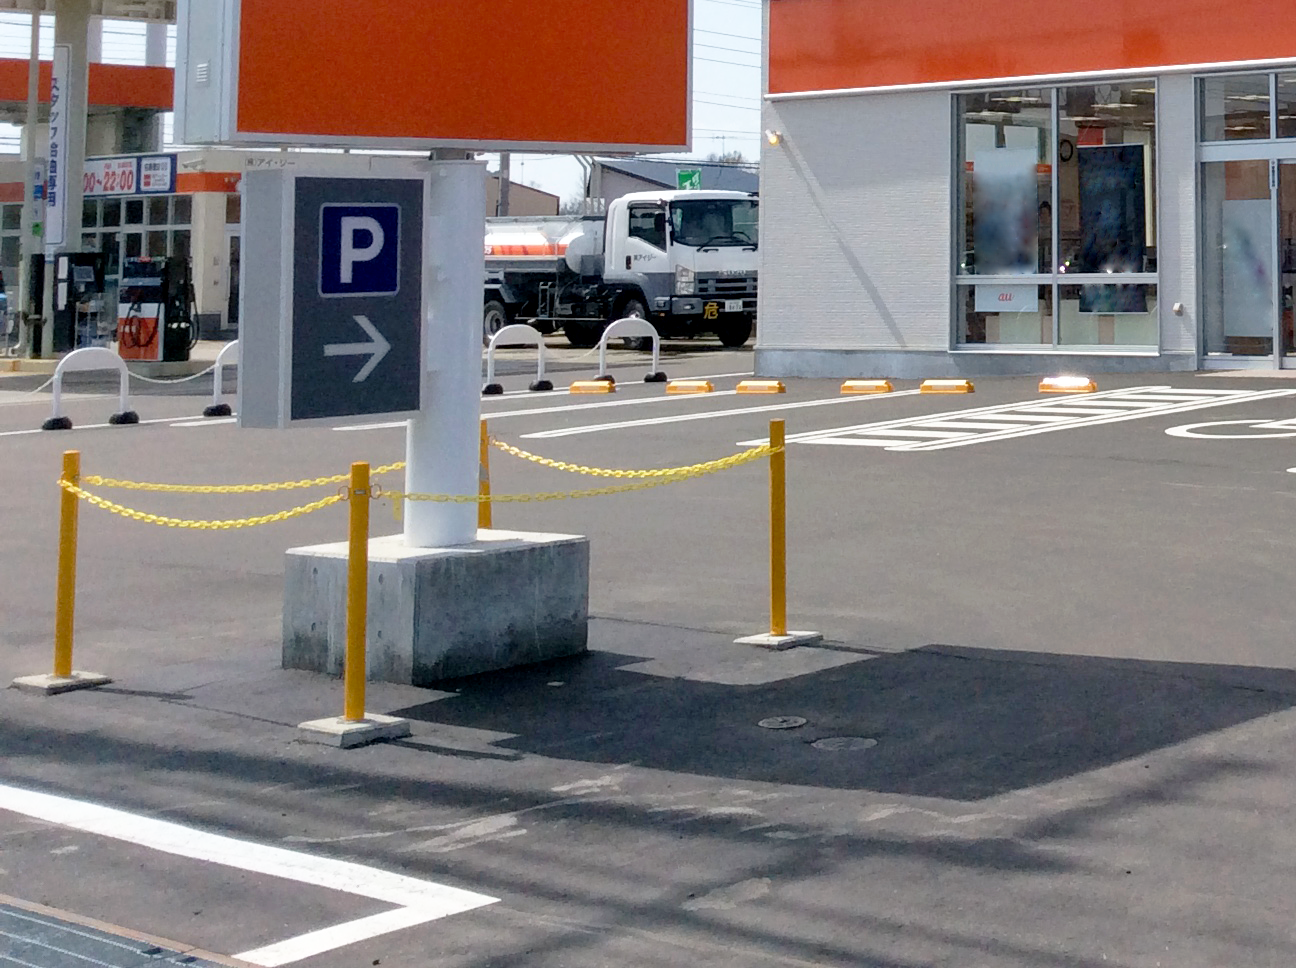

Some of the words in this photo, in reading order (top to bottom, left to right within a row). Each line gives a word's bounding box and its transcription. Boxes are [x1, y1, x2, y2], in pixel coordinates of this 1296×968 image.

[341, 215, 385, 283] P
[997, 290, 1014, 302] au
[703, 301, 720, 320] 危
